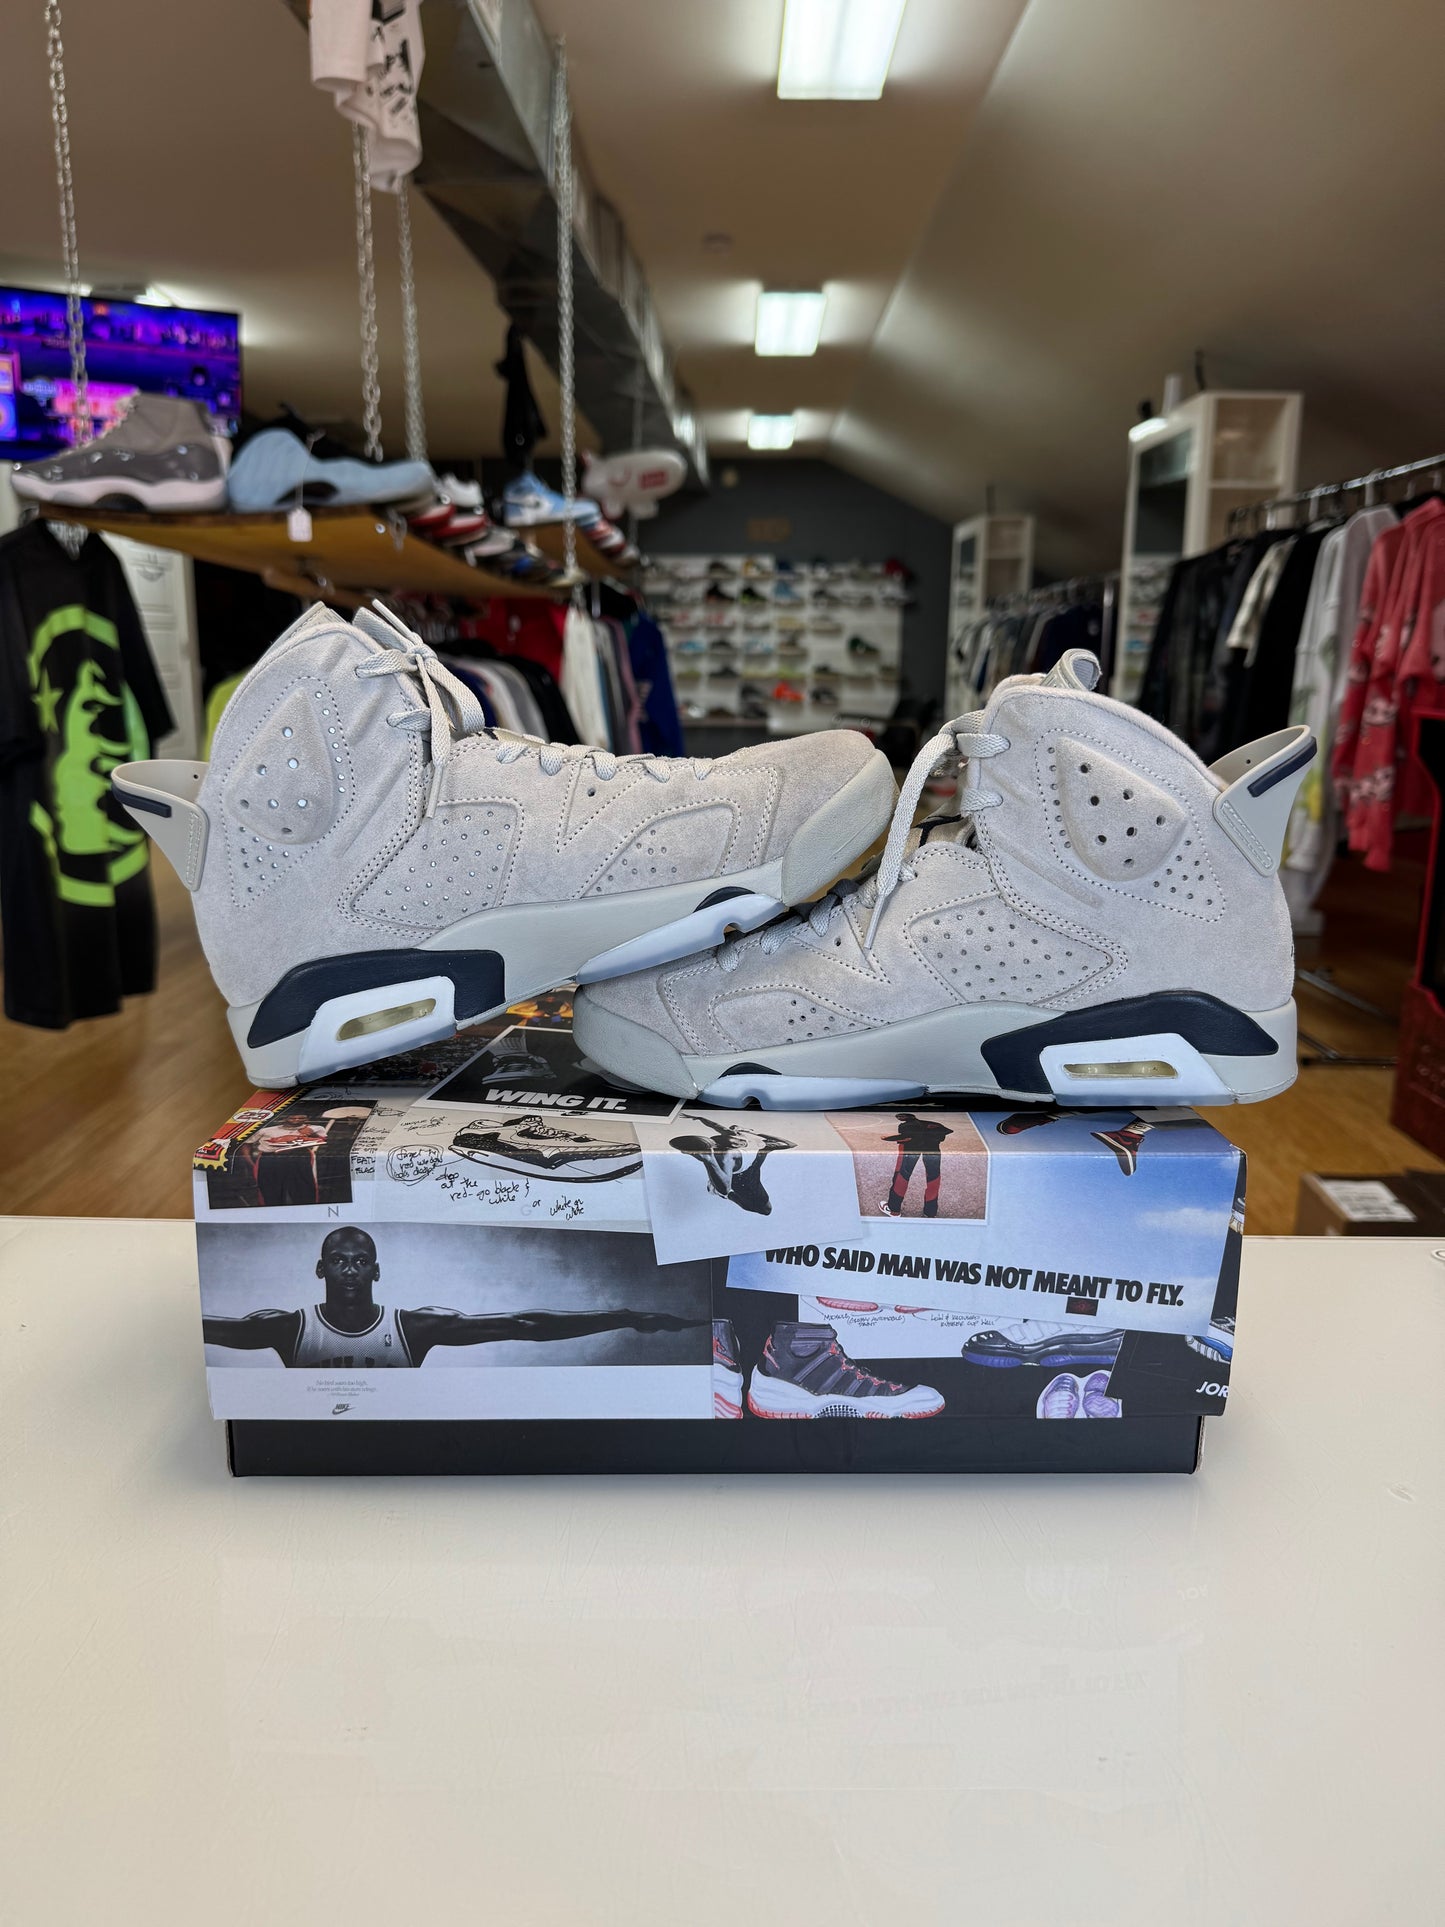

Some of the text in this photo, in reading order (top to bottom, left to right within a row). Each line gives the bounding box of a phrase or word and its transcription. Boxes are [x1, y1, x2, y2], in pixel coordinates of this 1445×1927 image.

[485, 1088, 586, 1107] WING
[586, 1096, 628, 1111] IT.
[236, 1111, 270, 1120] 23
[328, 1205, 339, 1218] N
[765, 1244, 1184, 1307] WHO SAID MAN WAS NOT MEANT TO FLY.
